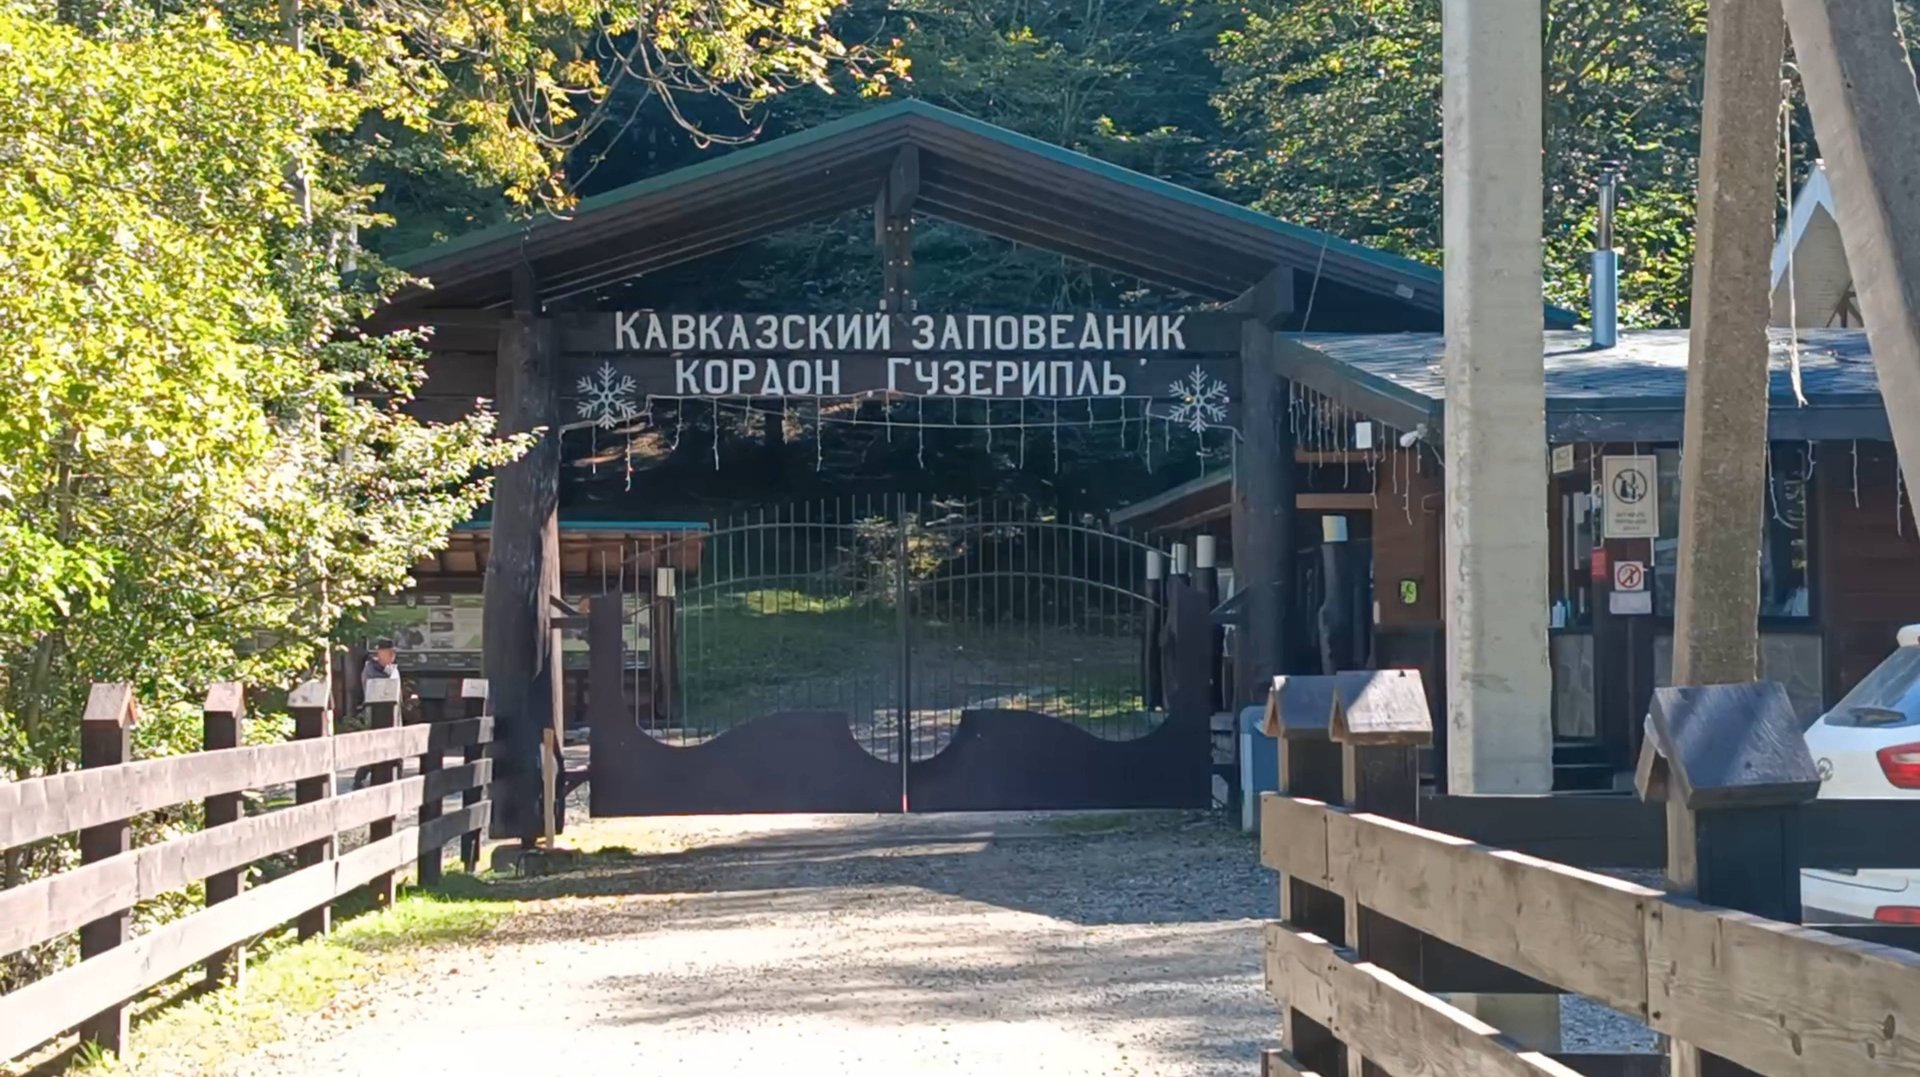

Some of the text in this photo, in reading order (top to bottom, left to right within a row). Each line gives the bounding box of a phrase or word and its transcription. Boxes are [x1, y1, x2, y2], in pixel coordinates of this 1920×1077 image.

[615, 311, 1186, 350] КАВКАЗСКИЙ ЗАПОВЕДНИК
[676, 358, 1127, 395] КОРДОН ГУЗЕРИПЛЬ
